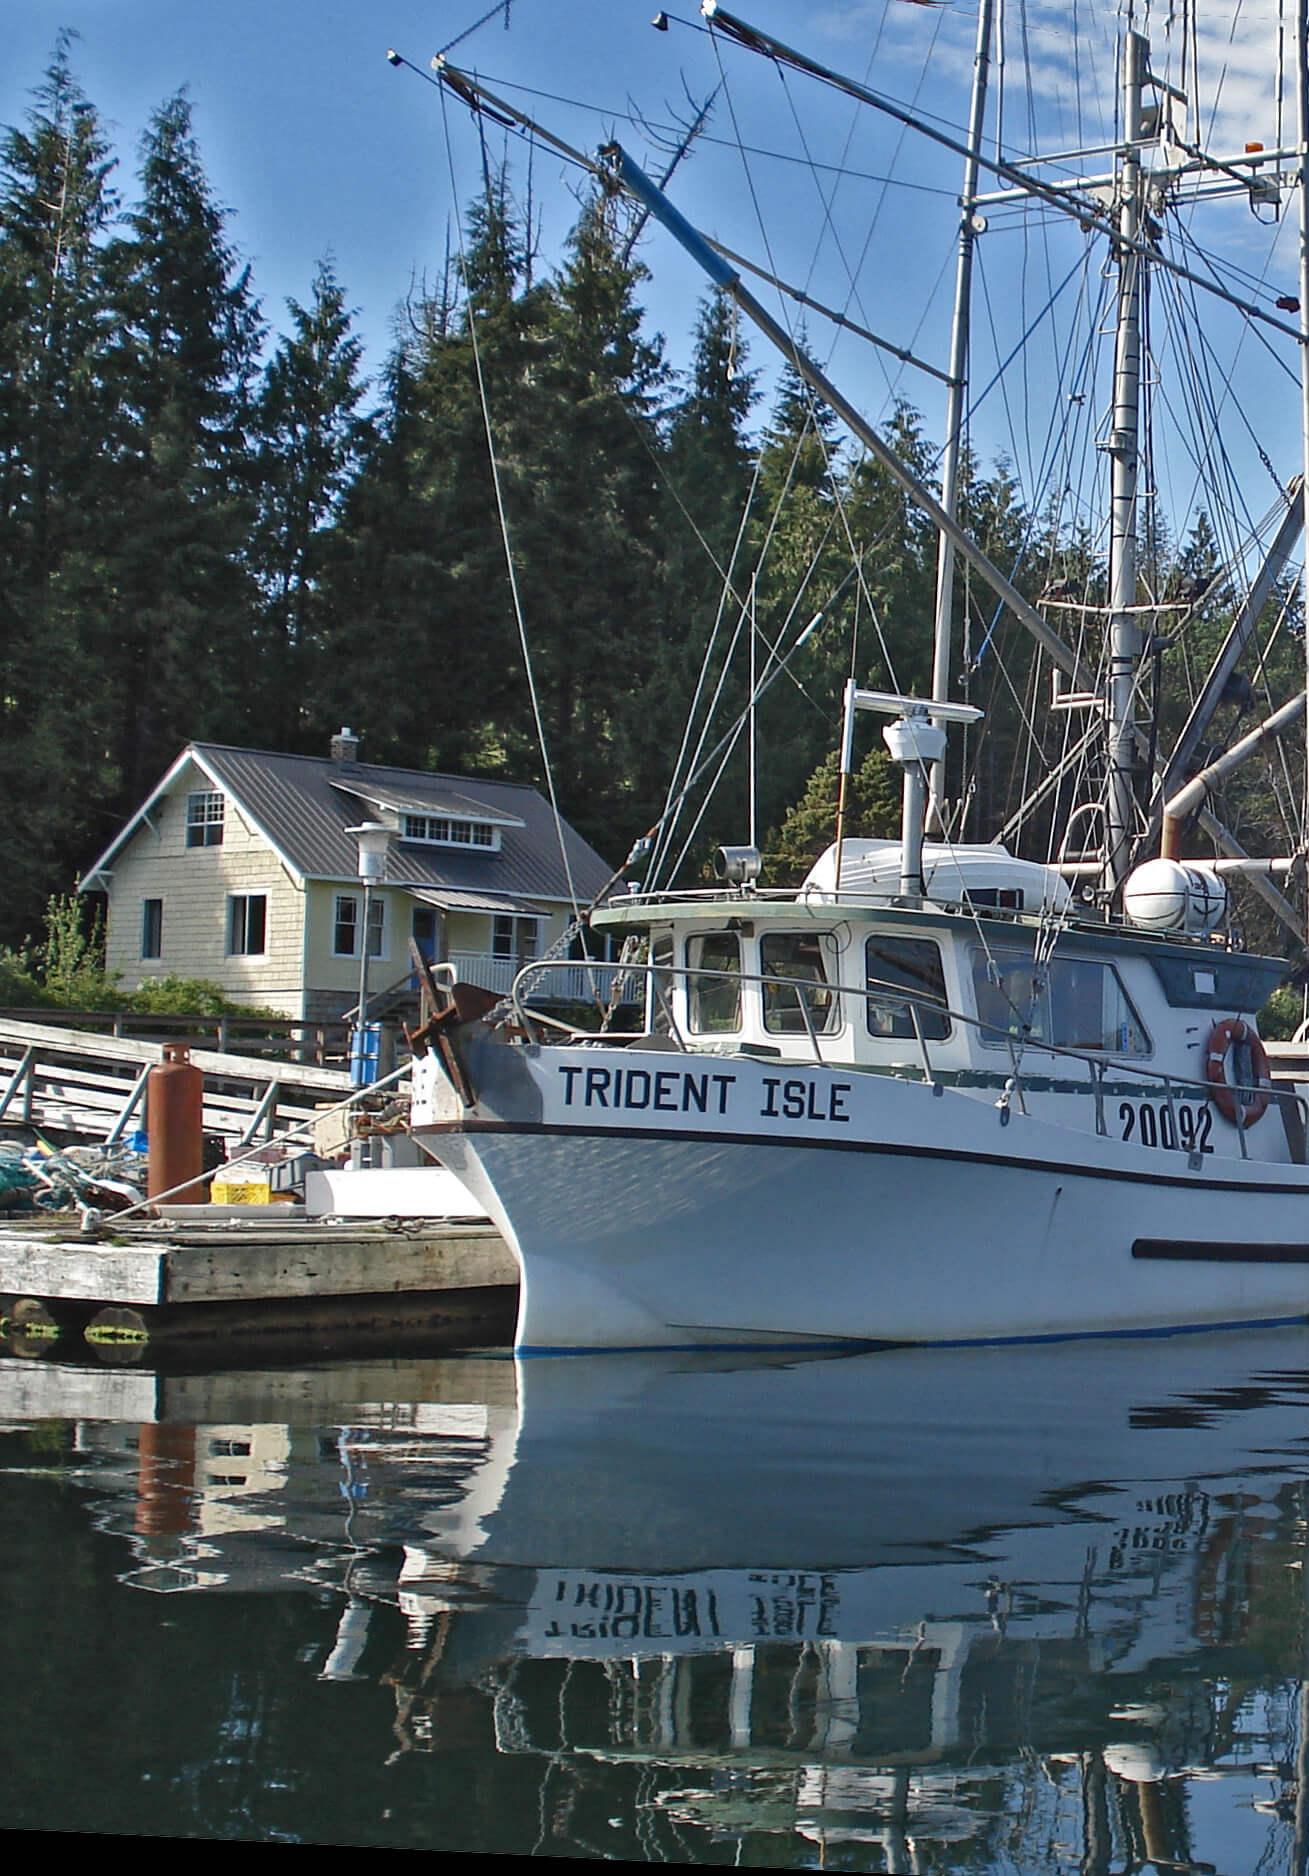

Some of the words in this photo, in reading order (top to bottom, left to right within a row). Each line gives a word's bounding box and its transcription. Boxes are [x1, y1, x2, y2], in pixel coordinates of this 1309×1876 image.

[558, 1066, 736, 1114] TRIDENT
[760, 1077, 852, 1122] ISLE
[1119, 1102, 1215, 1154] 20092
